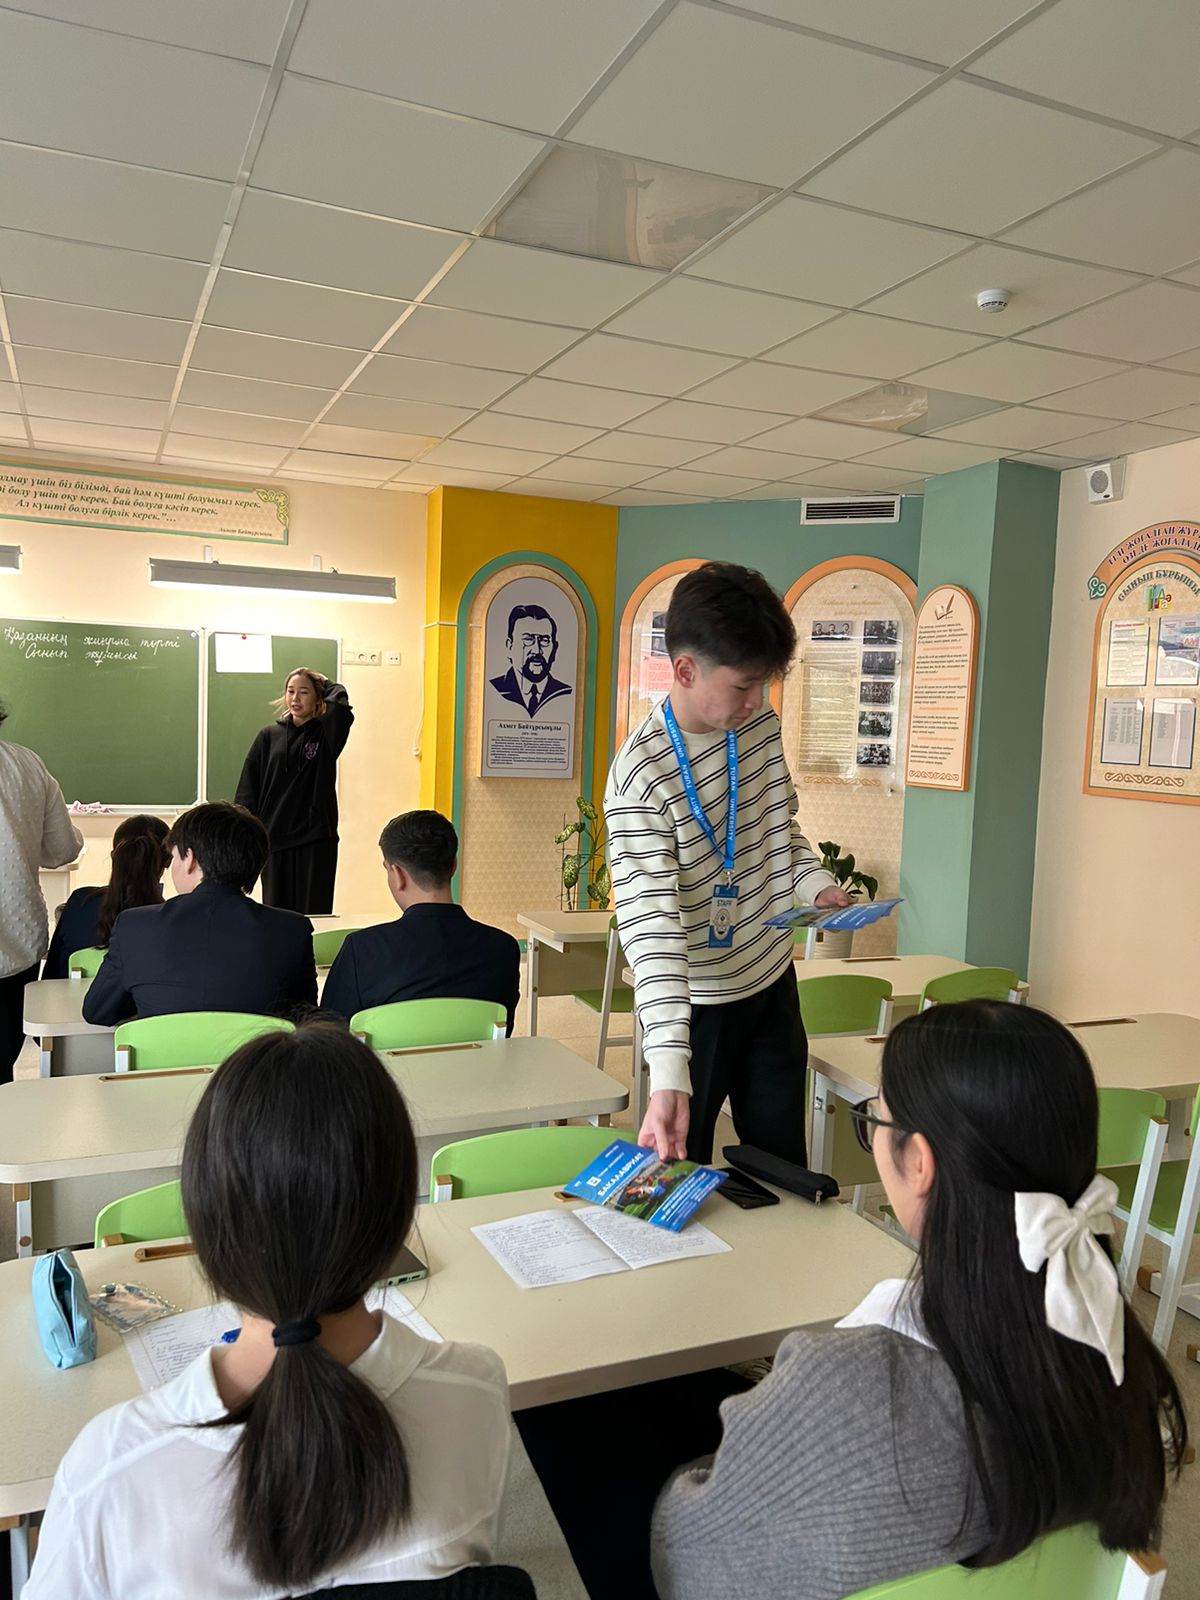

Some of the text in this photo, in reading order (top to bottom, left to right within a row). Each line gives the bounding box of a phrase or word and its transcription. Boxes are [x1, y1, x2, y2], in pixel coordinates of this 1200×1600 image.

[9, 486, 31, 497] болу
[112, 497, 131, 506] Бай
[59, 479, 72, 488] біз
[114, 485, 131, 494] бай
[16, 499, 29, 508] Ал
[667, 719, 684, 758] UNIVERSITY
[682, 764, 693, 789] TURAN
[728, 798, 736, 841] UNIVERSITY
